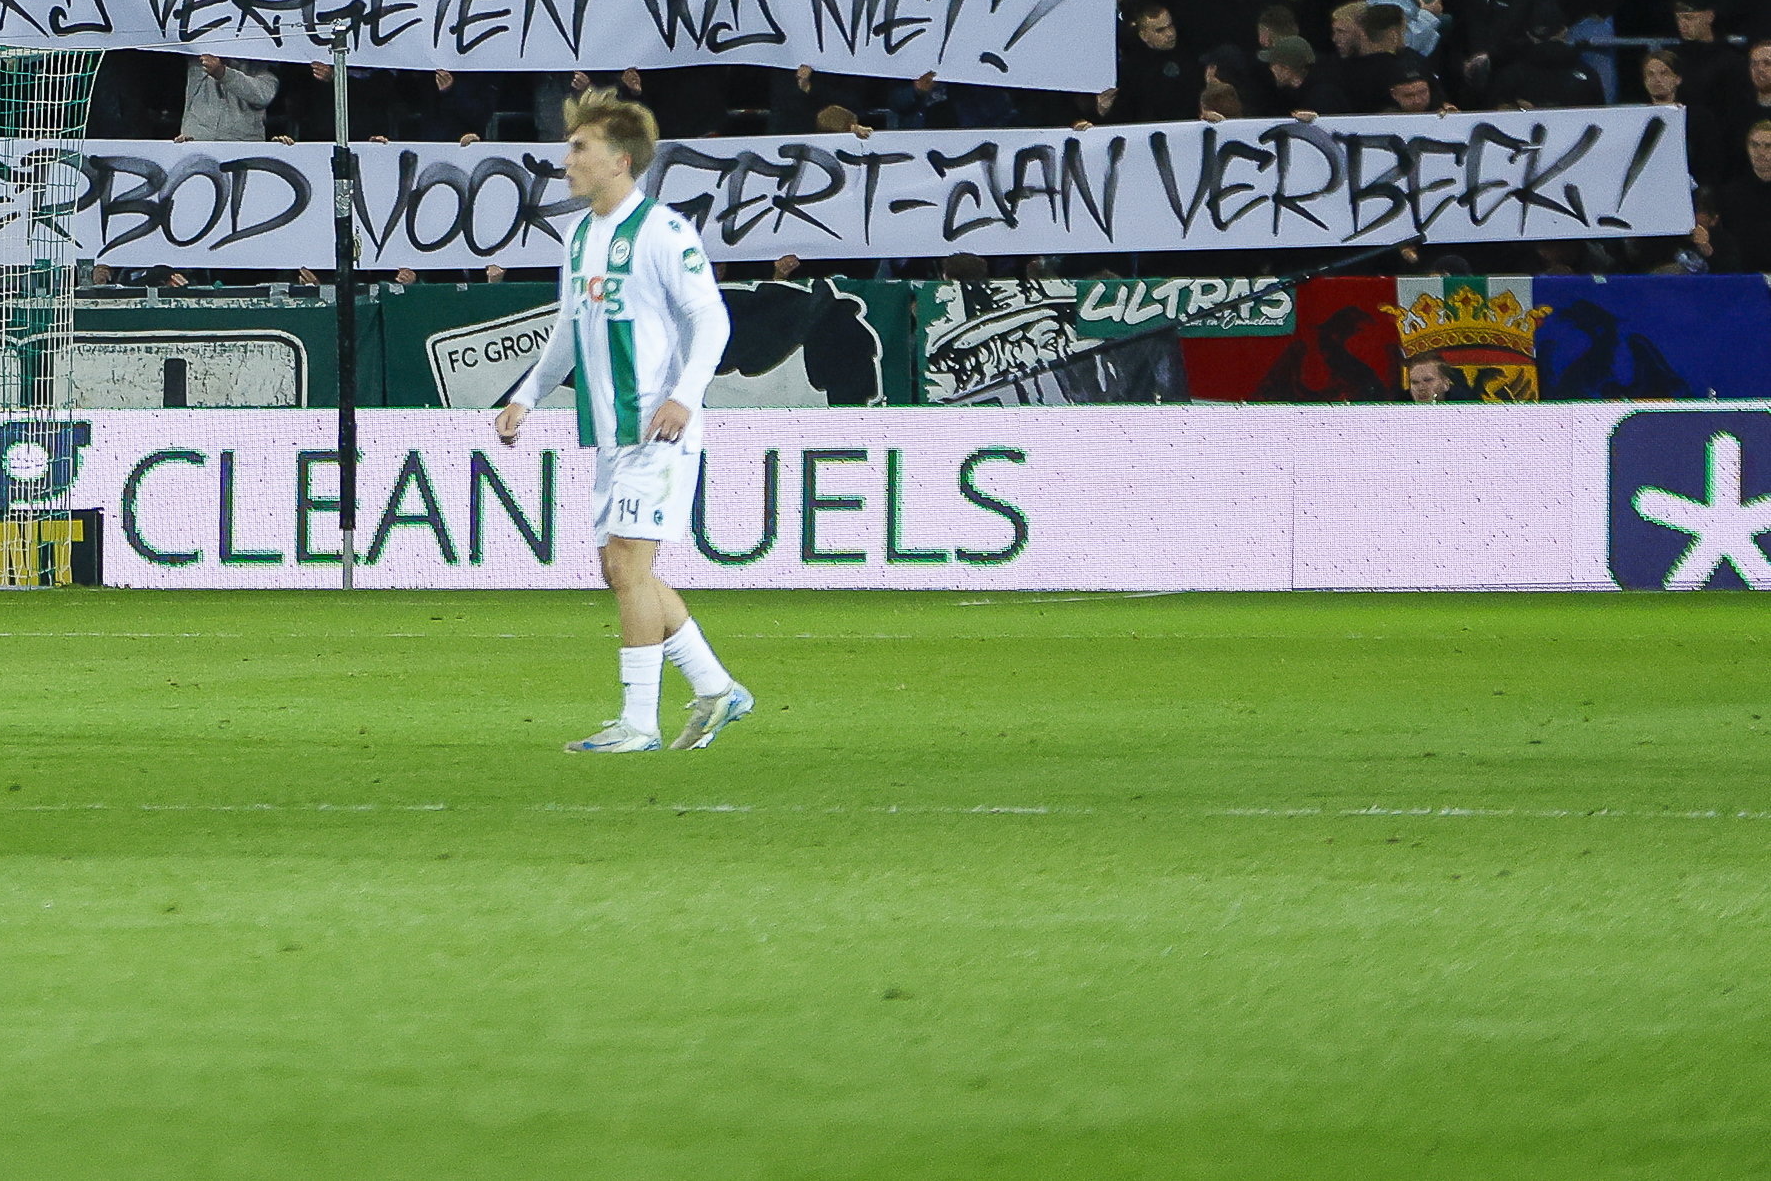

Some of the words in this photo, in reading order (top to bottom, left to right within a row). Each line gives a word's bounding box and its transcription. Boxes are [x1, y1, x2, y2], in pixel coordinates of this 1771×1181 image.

[1149, 116, 1667, 243] VERBEEK!
[1079, 277, 1293, 325] ULTRAS
[448, 346, 479, 373] FC
[483, 325, 554, 363] GRON
[121, 448, 557, 567] CLEAN
[692, 448, 1029, 566] UELS
[618, 498, 640, 523] 14
